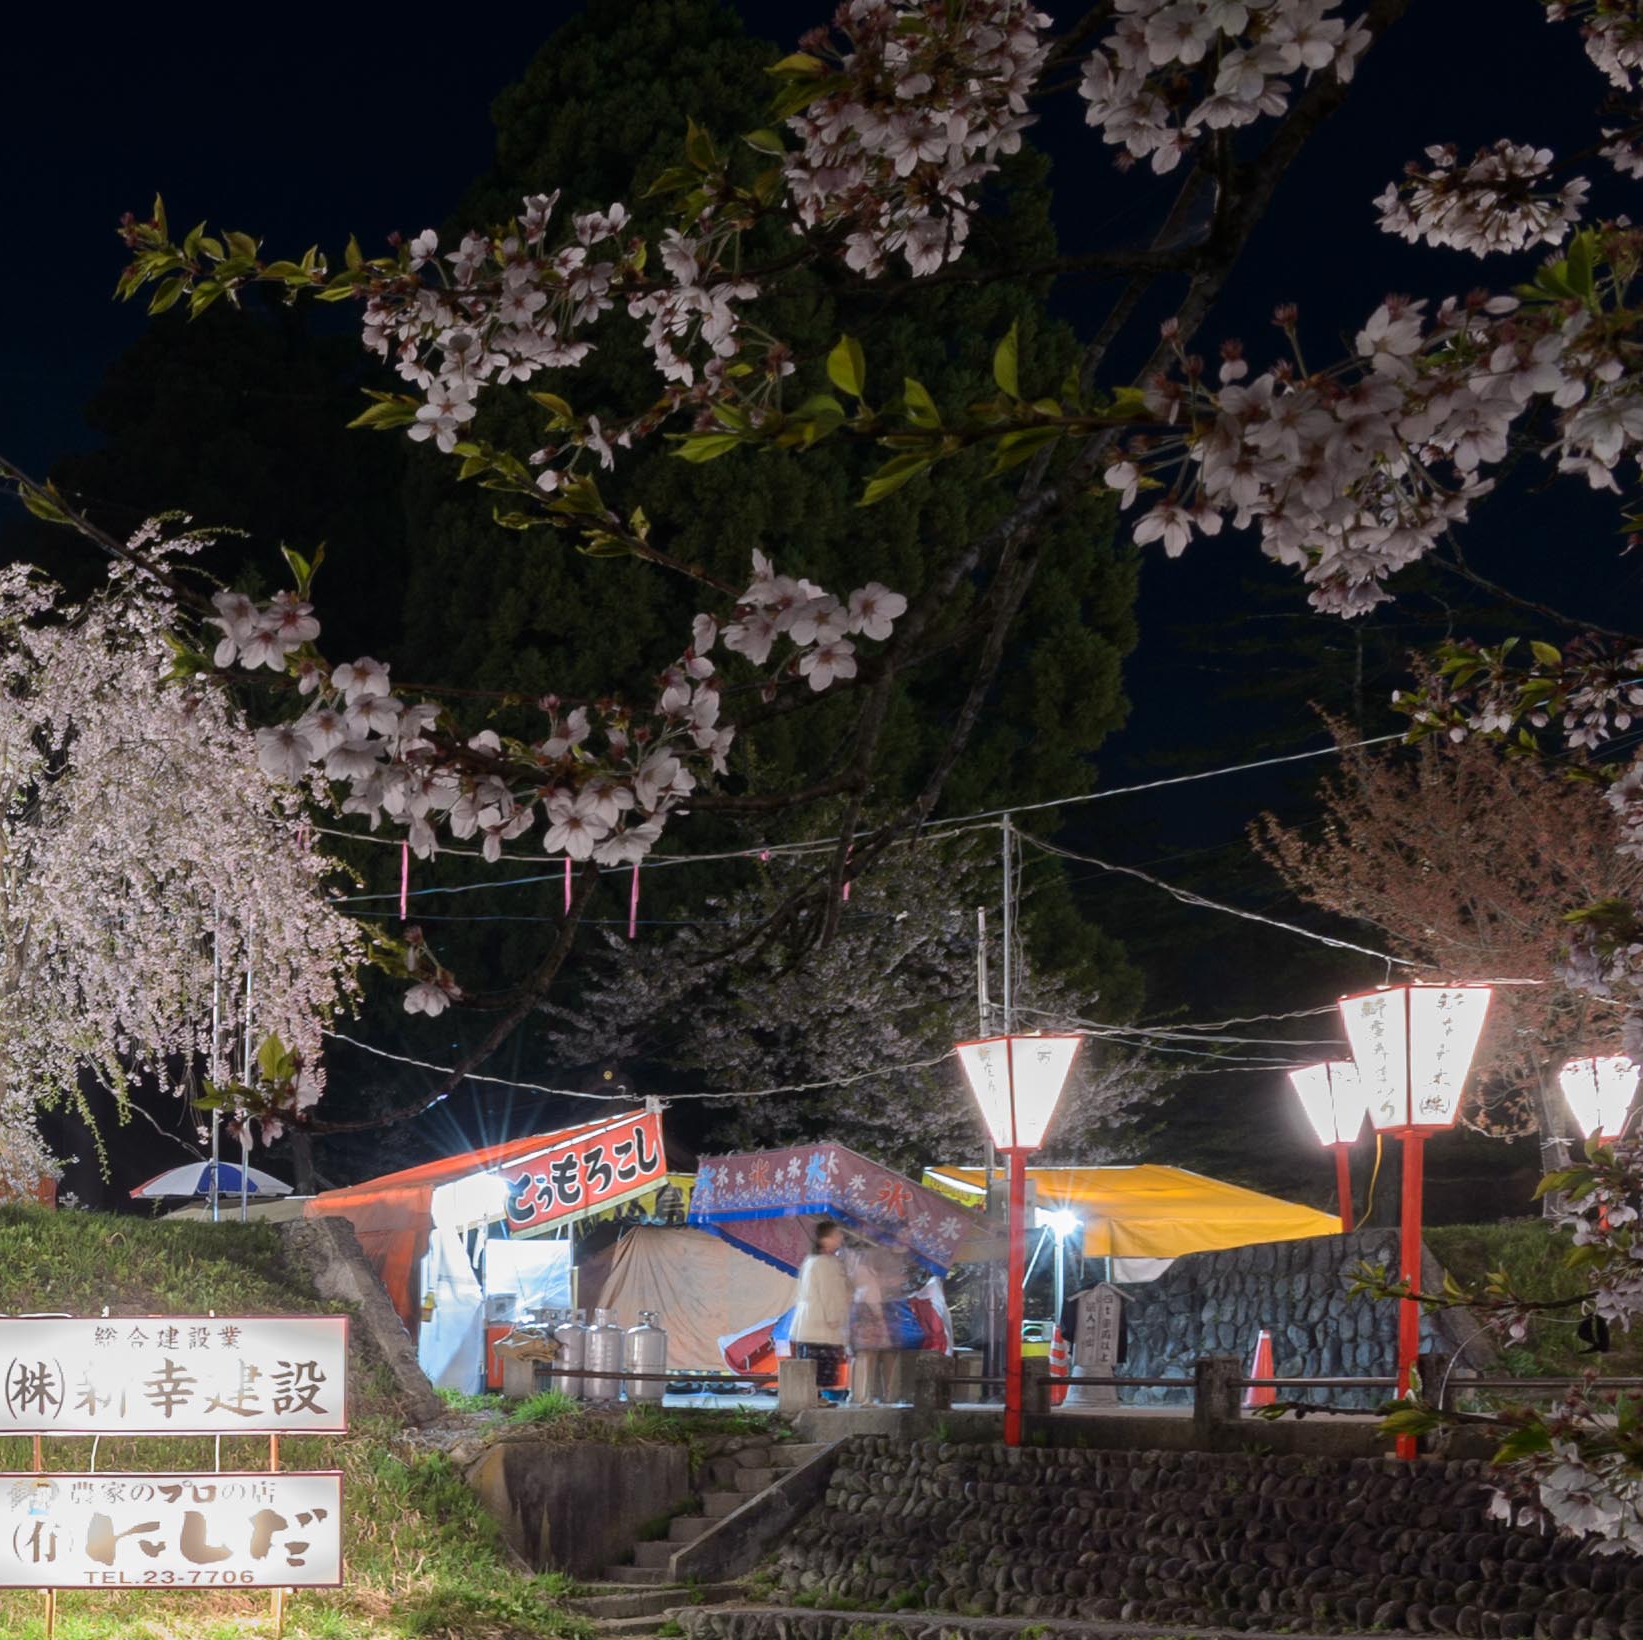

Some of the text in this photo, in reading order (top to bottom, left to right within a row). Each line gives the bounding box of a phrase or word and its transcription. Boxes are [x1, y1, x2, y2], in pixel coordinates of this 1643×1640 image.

[506, 1126, 659, 1224] とうもろこし
[93, 1325, 243, 1351] 総合建設業
[82, 1569, 255, 1585] TEL.23-7706
